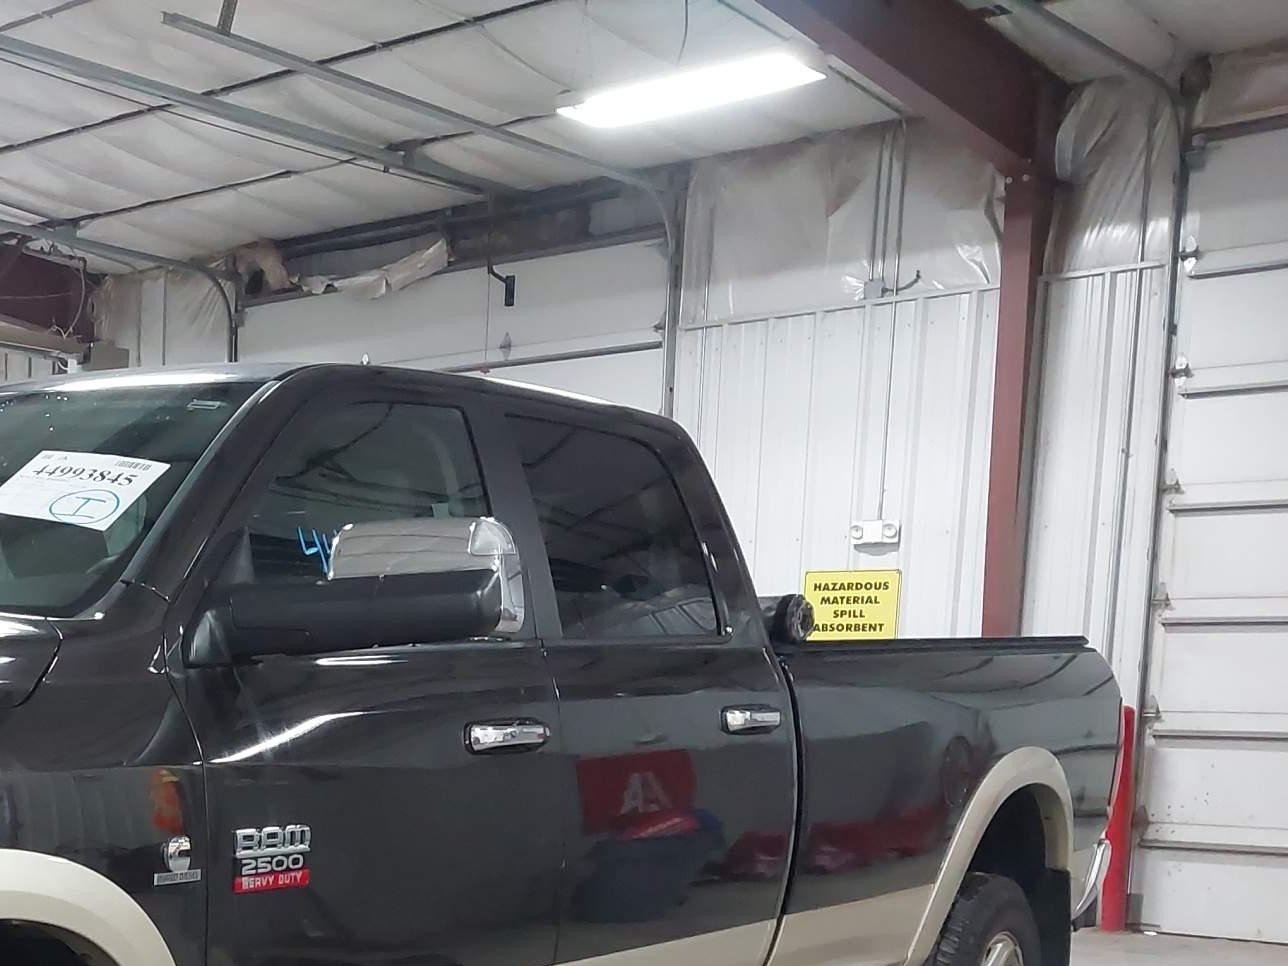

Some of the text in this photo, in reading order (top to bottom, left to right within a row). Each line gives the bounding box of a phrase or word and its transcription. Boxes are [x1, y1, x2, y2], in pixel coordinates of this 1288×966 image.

[32, 464, 139, 487] 44993845
[813, 581, 890, 592] HAZARDOUS
[820, 595, 881, 605] MATERIAL
[833, 609, 866, 619] SPILL
[813, 623, 885, 633] ABSORBENT
[235, 824, 312, 858] RAM
[241, 854, 304, 875] 2500
[241, 871, 303, 890] HEAVY DUTY
